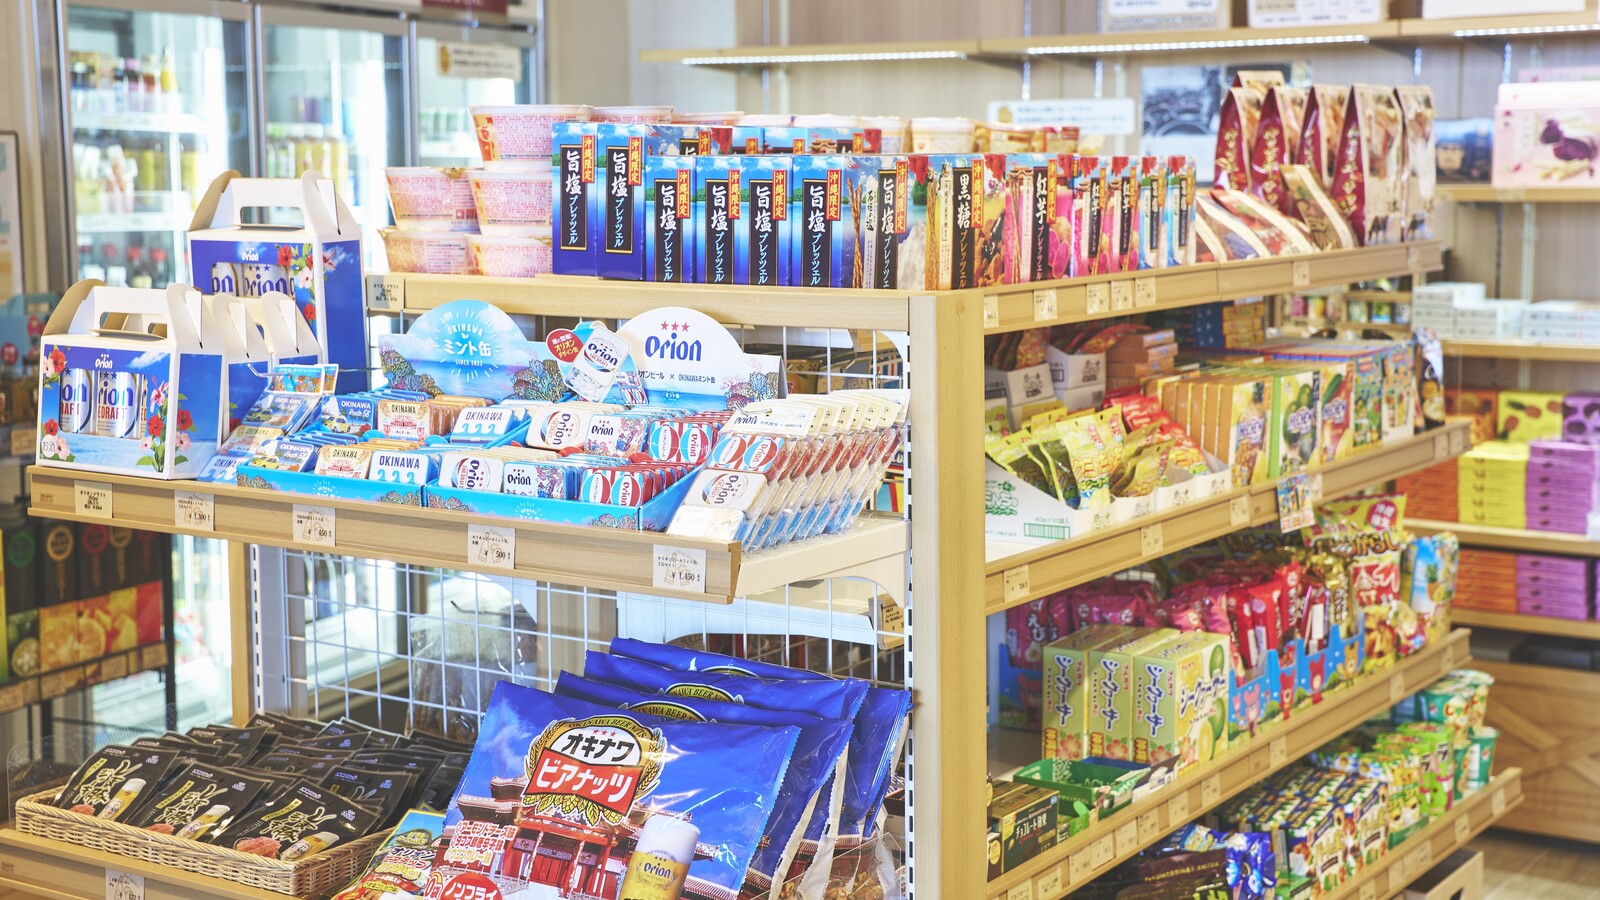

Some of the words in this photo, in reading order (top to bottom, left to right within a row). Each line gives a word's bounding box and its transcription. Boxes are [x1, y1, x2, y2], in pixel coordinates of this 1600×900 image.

[584, 136, 593, 182] 沖縄限定
[630, 138, 640, 184] 沖縄限定
[566, 150, 582, 246] 旨塩プレッツェル
[610, 151, 628, 248] 旨塩プレッツェル
[679, 170, 688, 217] 沖縄限定
[730, 170, 740, 217] 沖縄限定
[776, 170, 785, 218] 沖縄限定
[828, 170, 838, 218] 沖縄限定
[898, 163, 908, 231] 沖縄限定
[972, 162, 982, 226] 沖縄限定
[659, 184, 677, 283] 旨塩プレッツェル
[711, 184, 728, 284] 旨塩プレッツェル
[754, 185, 773, 286] 旨塩プレッツェル
[808, 185, 825, 286] 旨塩プレッツェル
[447, 324, 484, 336] OKINAWA
[444, 339, 492, 357] ミント缶
[554, 340, 576, 352] オリオン
[588, 342, 618, 366] Orion
[644, 332, 702, 362] Orion
[95, 354, 113, 369] Orion
[340, 400, 371, 410] OKINAWA
[348, 408, 362, 416] Route
[362, 409, 370, 418] 58
[392, 404, 416, 414] OKINAWA
[465, 411, 503, 422] OKINAWA
[552, 413, 571, 446] Orion
[591, 424, 614, 436] Orion
[734, 416, 758, 424] Orion
[42, 440, 56, 452] お酒
[280, 444, 311, 452] OKINAWA
[332, 449, 358, 459] OKINAWA
[690, 434, 698, 457] Orion
[754, 444, 768, 462] Orion
[379, 456, 420, 468] OKINAWA
[466, 460, 480, 490] Orio
[507, 473, 531, 486] Orion
[714, 475, 740, 504] Orion
[495, 550, 506, 558] 500
[679, 572, 695, 581] 1,450
[568, 718, 609, 728] OKINAWA
[610, 718, 631, 730] BEER
[562, 733, 635, 762] オキナワ
[536, 757, 632, 802] ビアナッツ
[390, 847, 436, 859] オリオン
[644, 862, 671, 878] Orion
